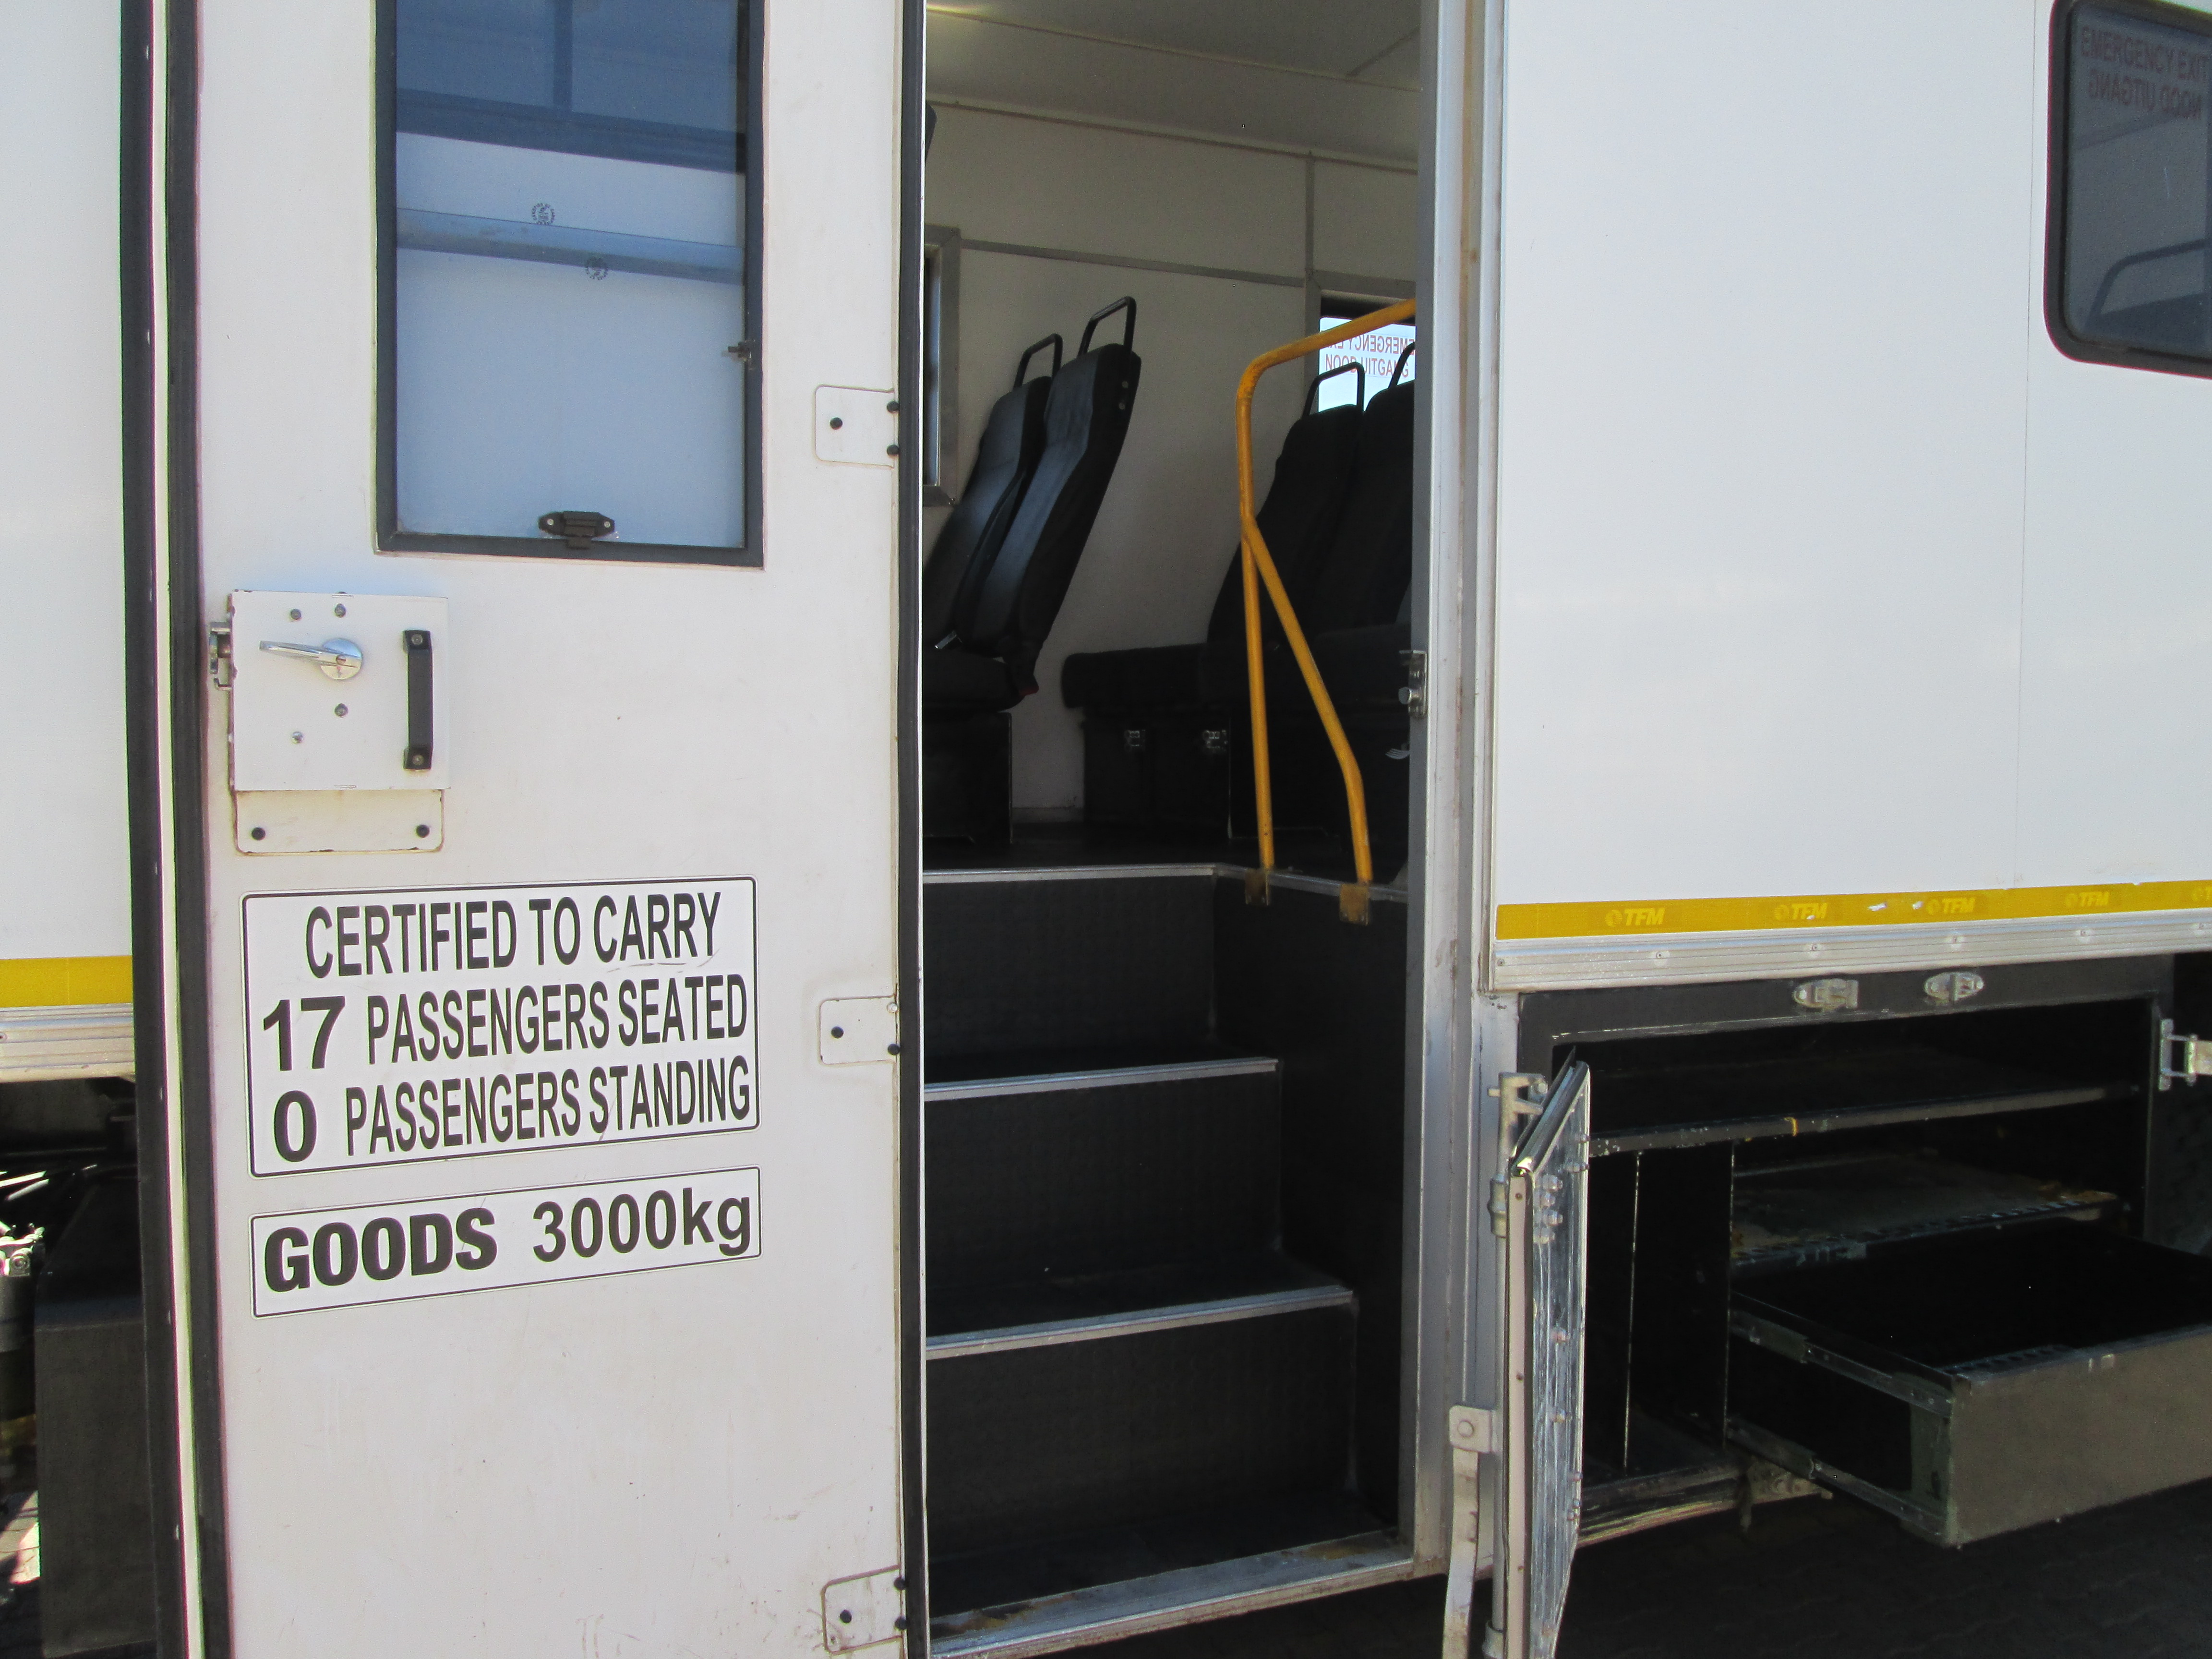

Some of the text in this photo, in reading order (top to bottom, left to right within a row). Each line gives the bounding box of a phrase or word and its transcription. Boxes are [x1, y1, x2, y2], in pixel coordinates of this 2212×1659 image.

[1361, 357, 1408, 377] UITGAG
[1624, 908, 1665, 926] TFM
[1791, 902, 1828, 920] TFM
[1942, 897, 1975, 914] TFM
[306, 892, 721, 978] CERTIFIED TO CARRY
[263, 974, 747, 1071] 17 PASSENGERS SEATED
[274, 1055, 749, 1163] 0 PASSENGERS STANDING
[264, 1188, 750, 1293] GOODS 3000kg
